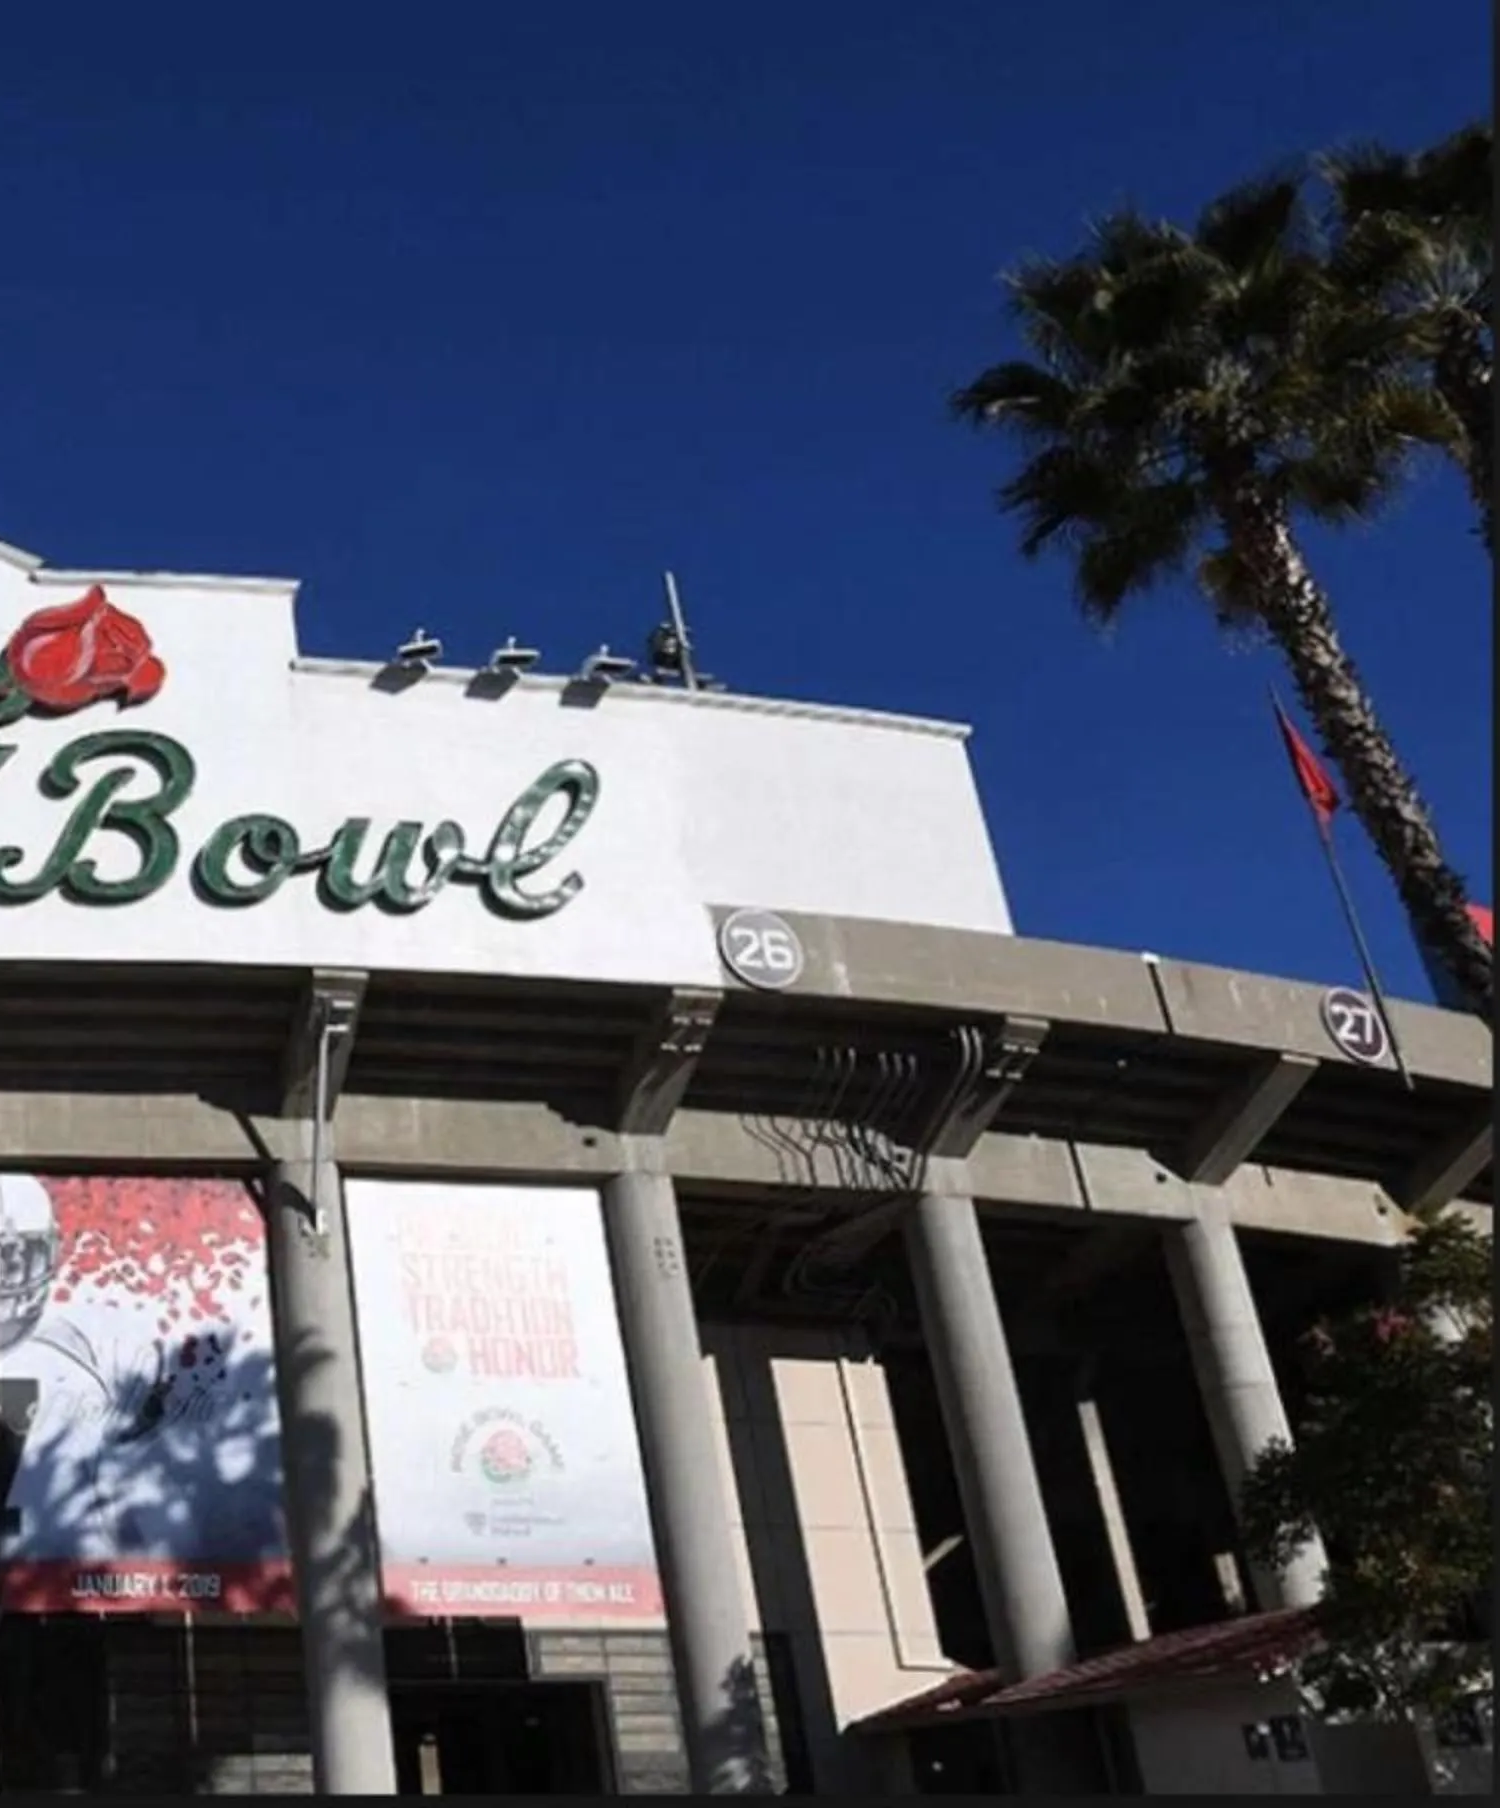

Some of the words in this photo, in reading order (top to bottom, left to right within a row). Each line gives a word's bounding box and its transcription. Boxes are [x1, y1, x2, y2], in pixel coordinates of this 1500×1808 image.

[730, 927, 794, 970] 26
[1330, 1003, 1373, 1045] 27
[402, 1251, 570, 1296] STRENGTH
[409, 1293, 578, 1337] TRADITION
[468, 1337, 581, 1379] HONOR
[71, 1571, 159, 1598] JANUARY
[178, 1572, 221, 1599] 2019
